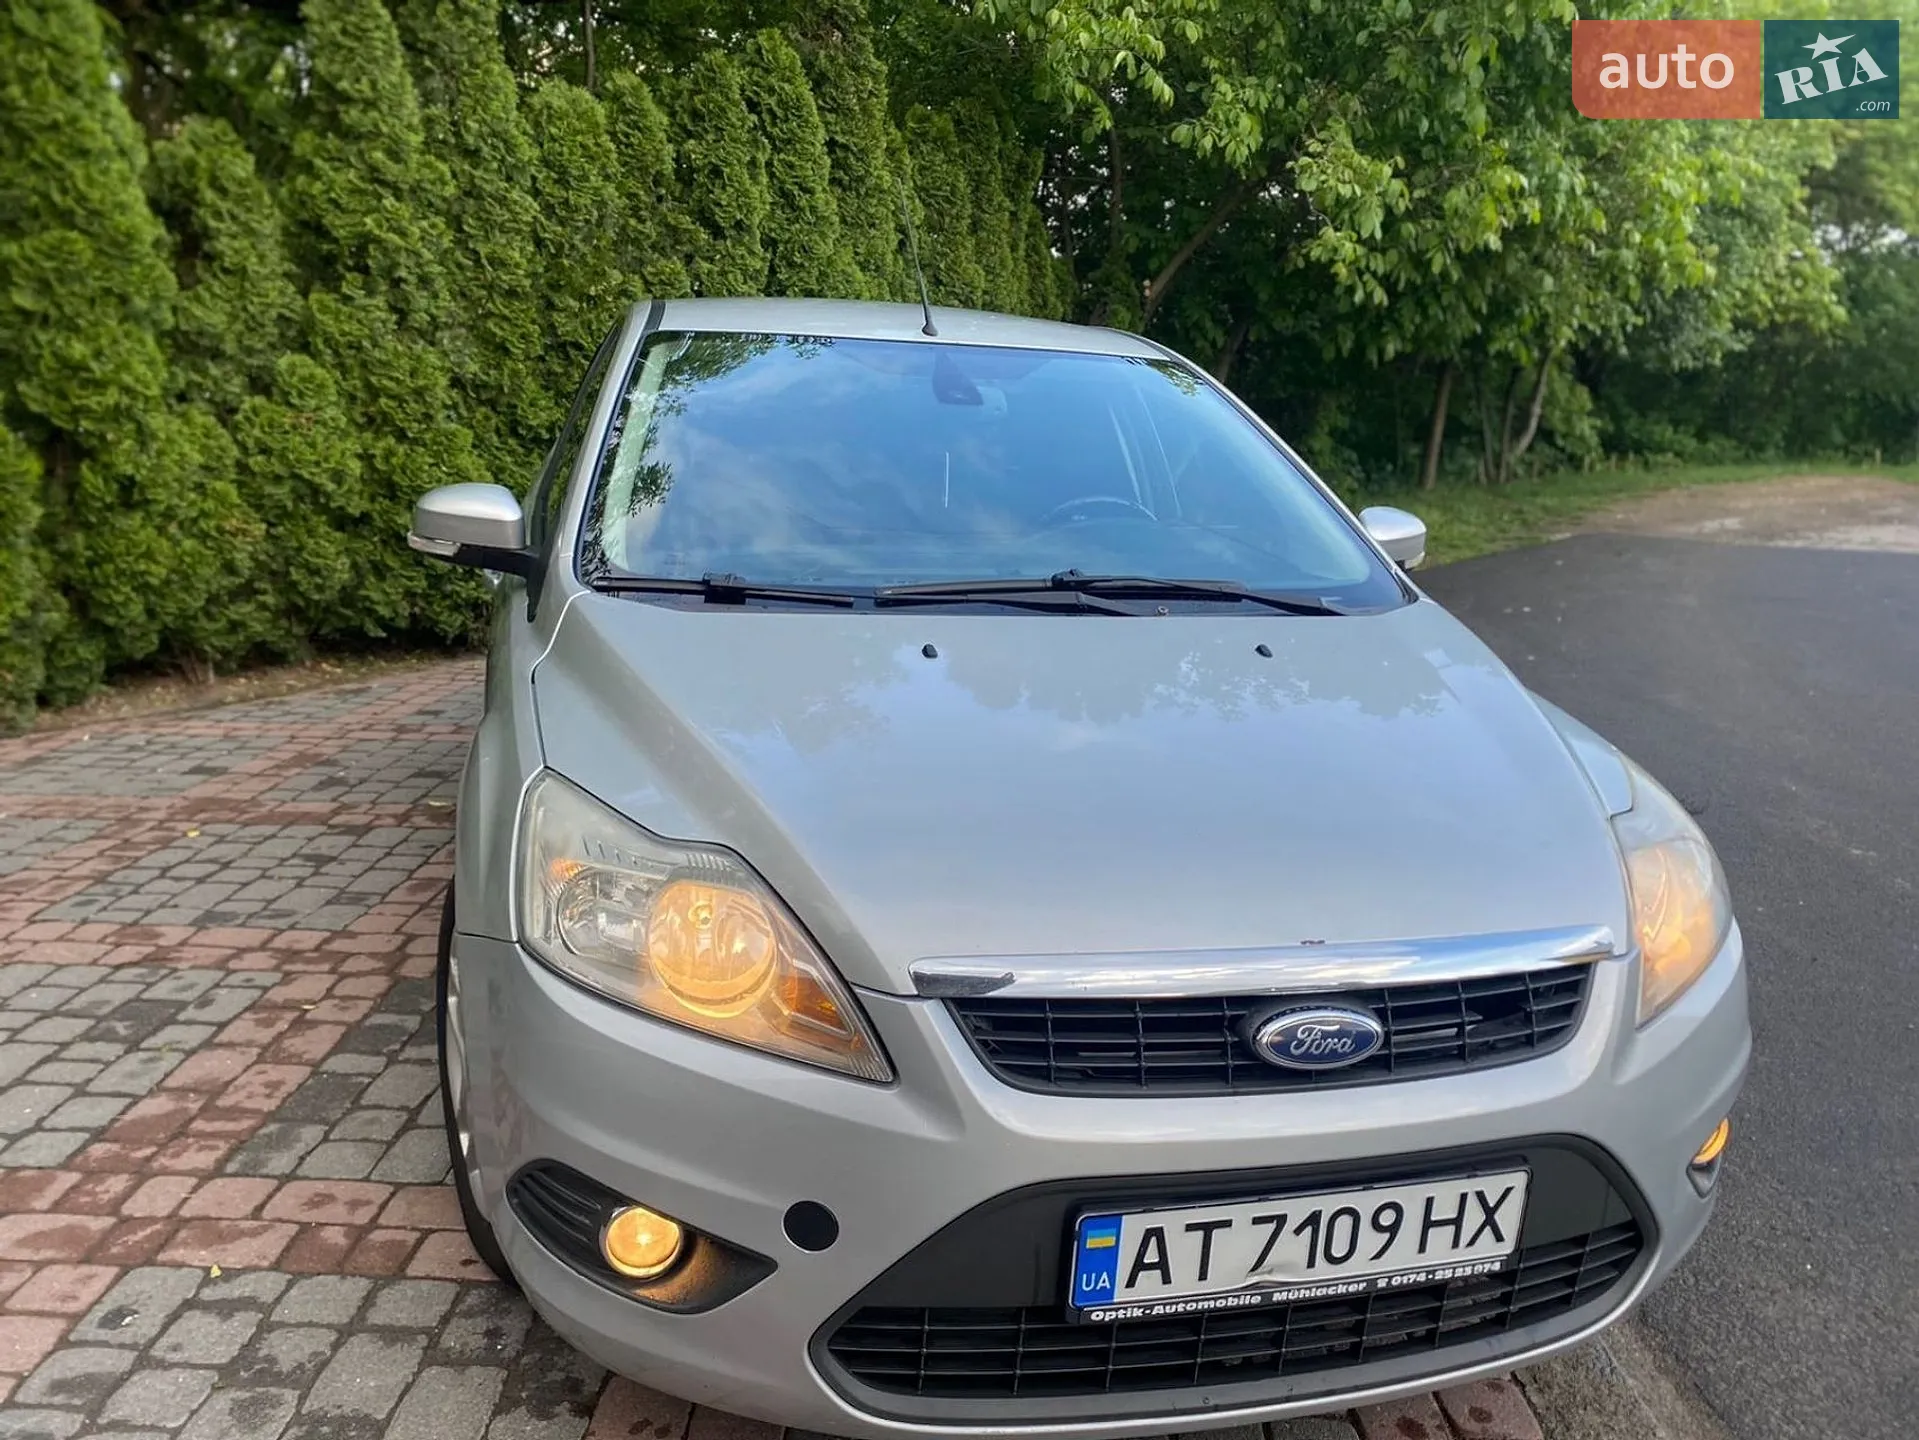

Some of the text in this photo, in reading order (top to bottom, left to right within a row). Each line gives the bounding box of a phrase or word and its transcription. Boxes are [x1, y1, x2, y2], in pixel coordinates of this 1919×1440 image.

[1289, 1024, 1357, 1056] Ford
[1124, 1185, 1516, 1290] AT 7109 HX
[1081, 1272, 1112, 1292] UA
[1090, 1293, 1262, 1322] Optik-Automobile
[1271, 1281, 1368, 1302] Mühlacker
